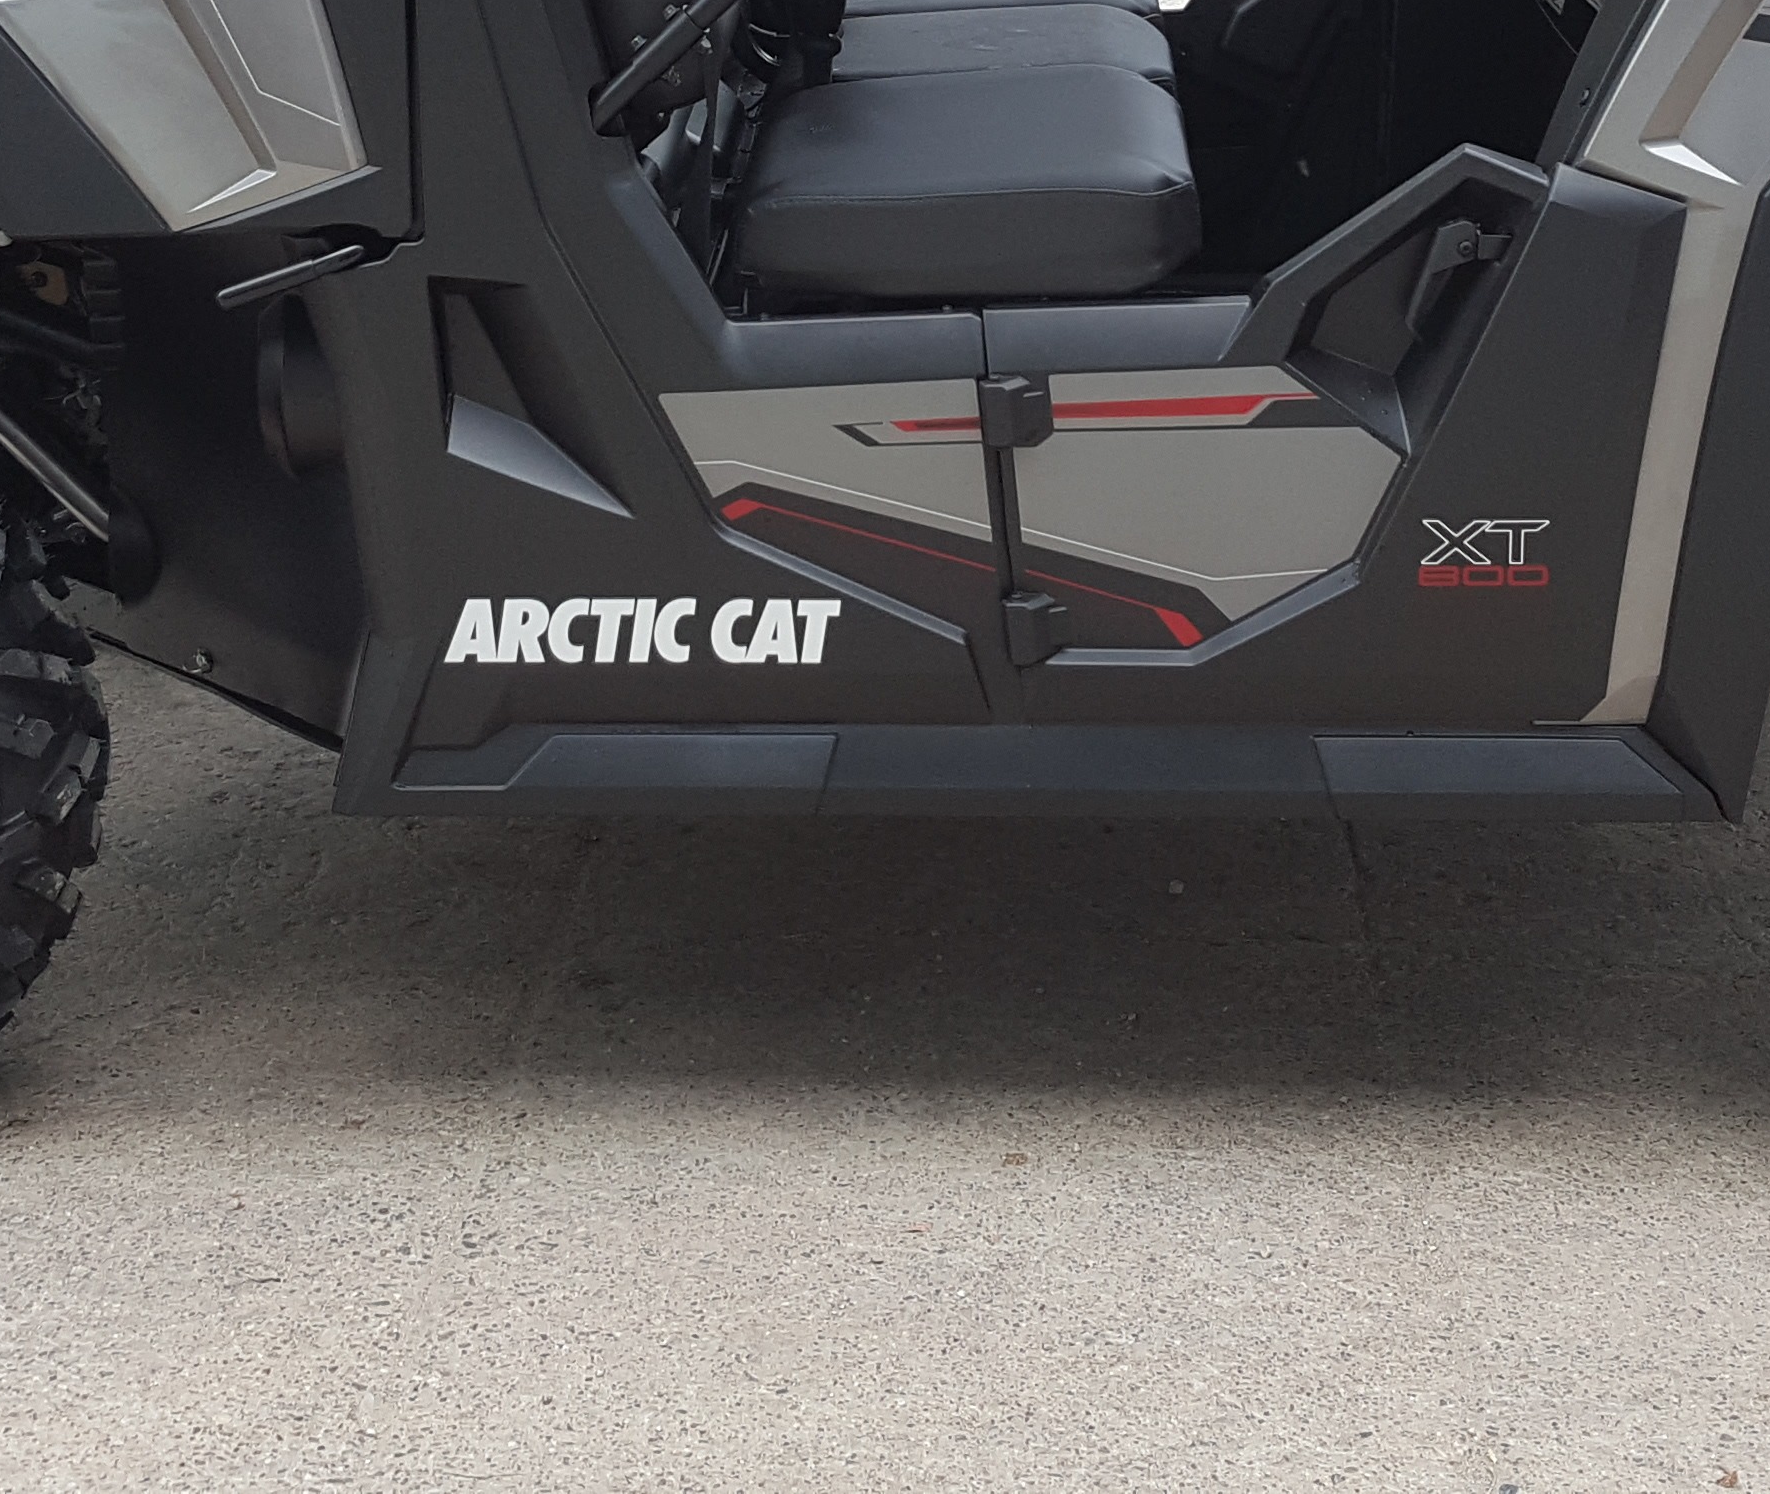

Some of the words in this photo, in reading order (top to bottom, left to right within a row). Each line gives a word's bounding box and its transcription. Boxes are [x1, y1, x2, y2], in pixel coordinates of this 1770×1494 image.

[1420, 518, 1551, 565] XT
[1418, 564, 1550, 587] 800
[443, 597, 697, 664] ARCTIC
[710, 598, 842, 664] CAT
